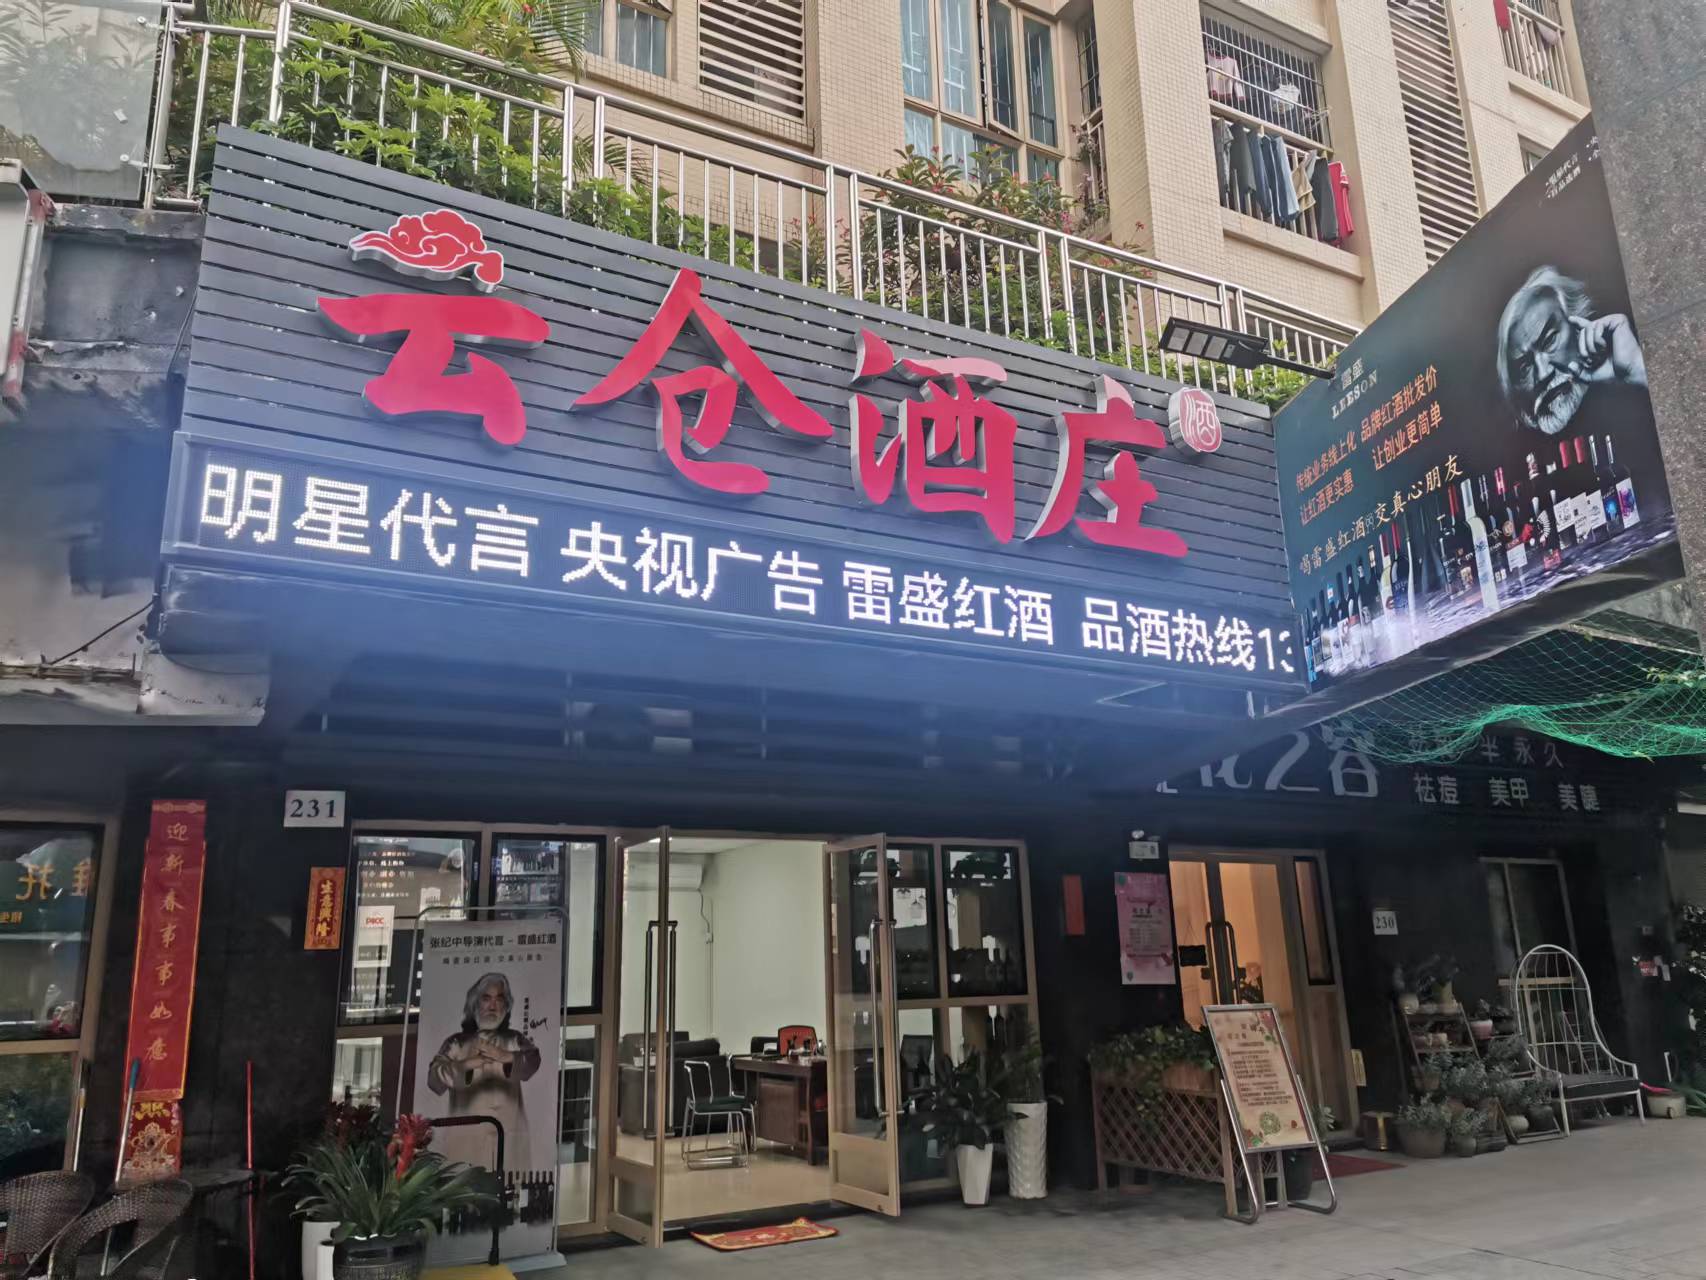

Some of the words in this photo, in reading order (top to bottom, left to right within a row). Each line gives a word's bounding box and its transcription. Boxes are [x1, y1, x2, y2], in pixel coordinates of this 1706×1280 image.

[317, 267, 1189, 557] 云仓酒庄
[1360, 364, 1438, 443] 品牌红酒批发价
[1300, 467, 1355, 526] 让红酒更实惠
[1371, 400, 1443, 471] 让创业更简单
[1375, 454, 1464, 527] 交真心朋友
[200, 464, 539, 578] 明星代言
[560, 521, 823, 617] 央视广告
[842, 560, 1055, 645] 雷盛红酒
[289, 799, 338, 819] 231
[1414, 772, 1460, 805] 祛痘
[1489, 776, 1529, 807] 美甲
